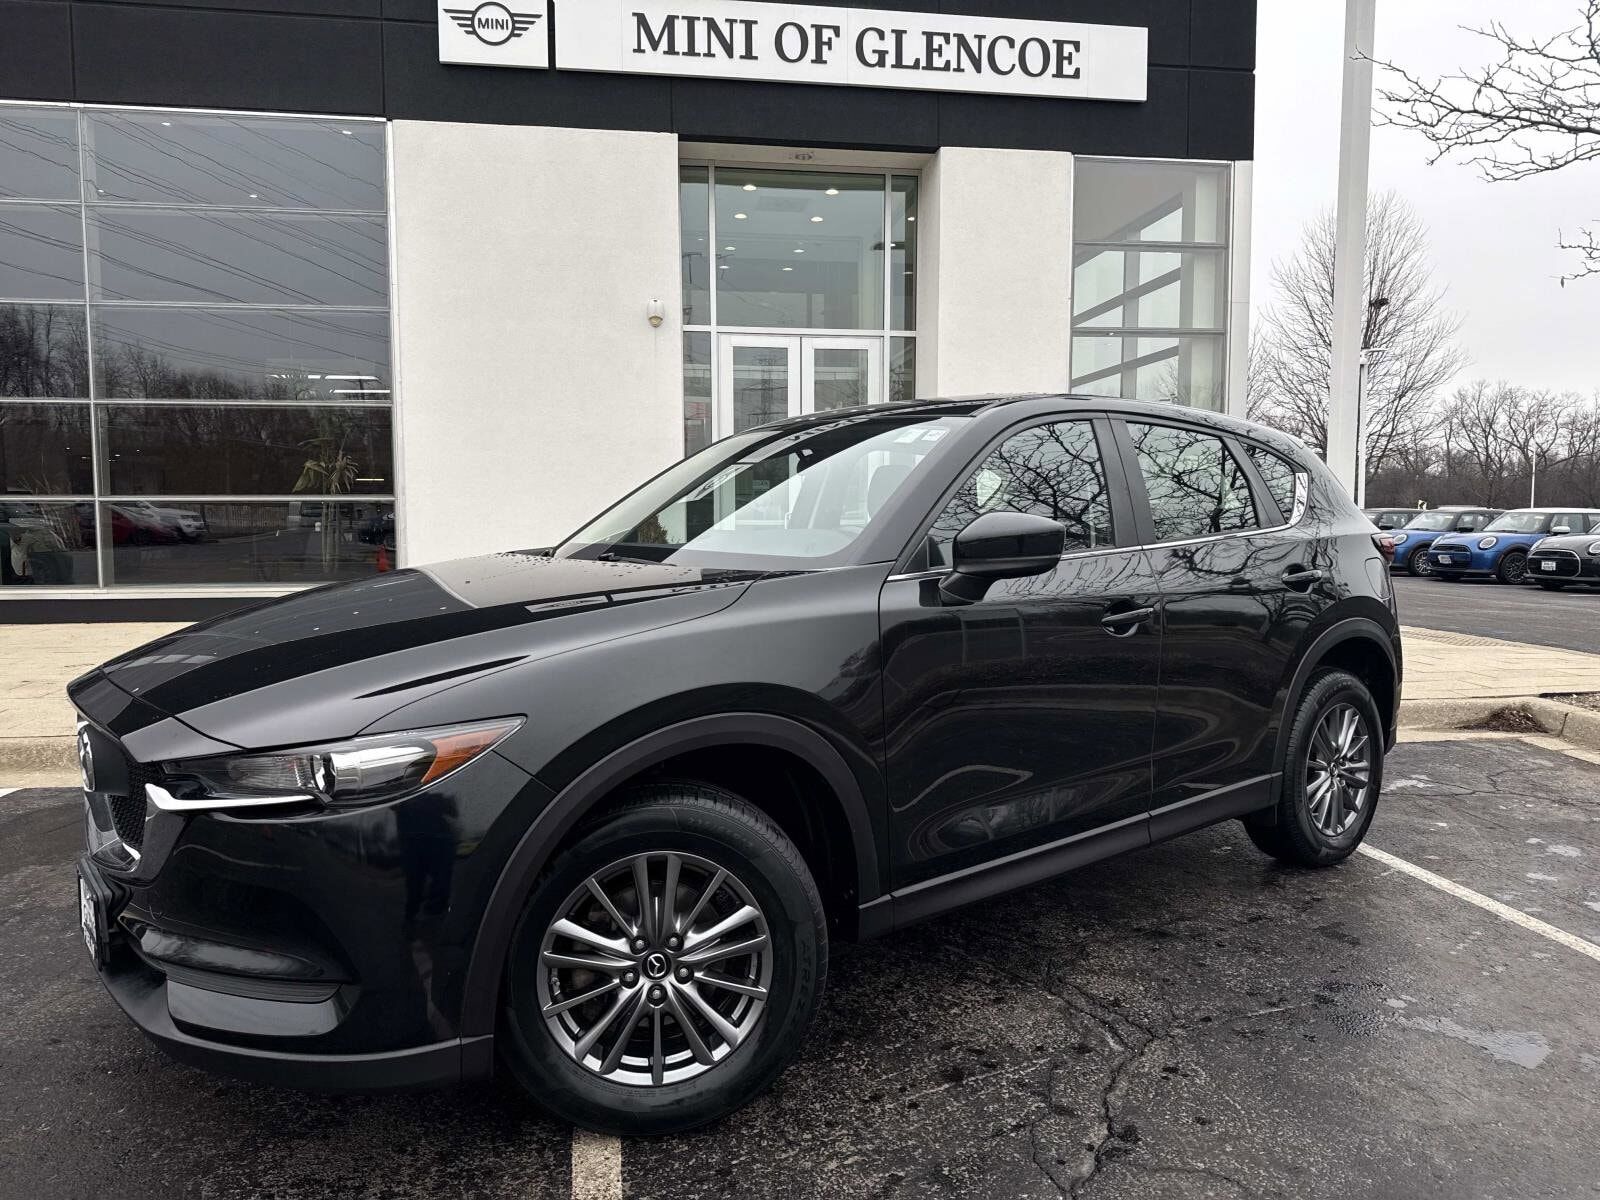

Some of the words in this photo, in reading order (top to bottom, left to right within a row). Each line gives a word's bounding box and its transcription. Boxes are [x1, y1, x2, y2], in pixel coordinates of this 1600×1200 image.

[477, 17, 509, 31] MINI
[632, 13, 759, 61] MINI
[774, 21, 841, 65] OF
[855, 26, 1081, 80] GLENCOE
